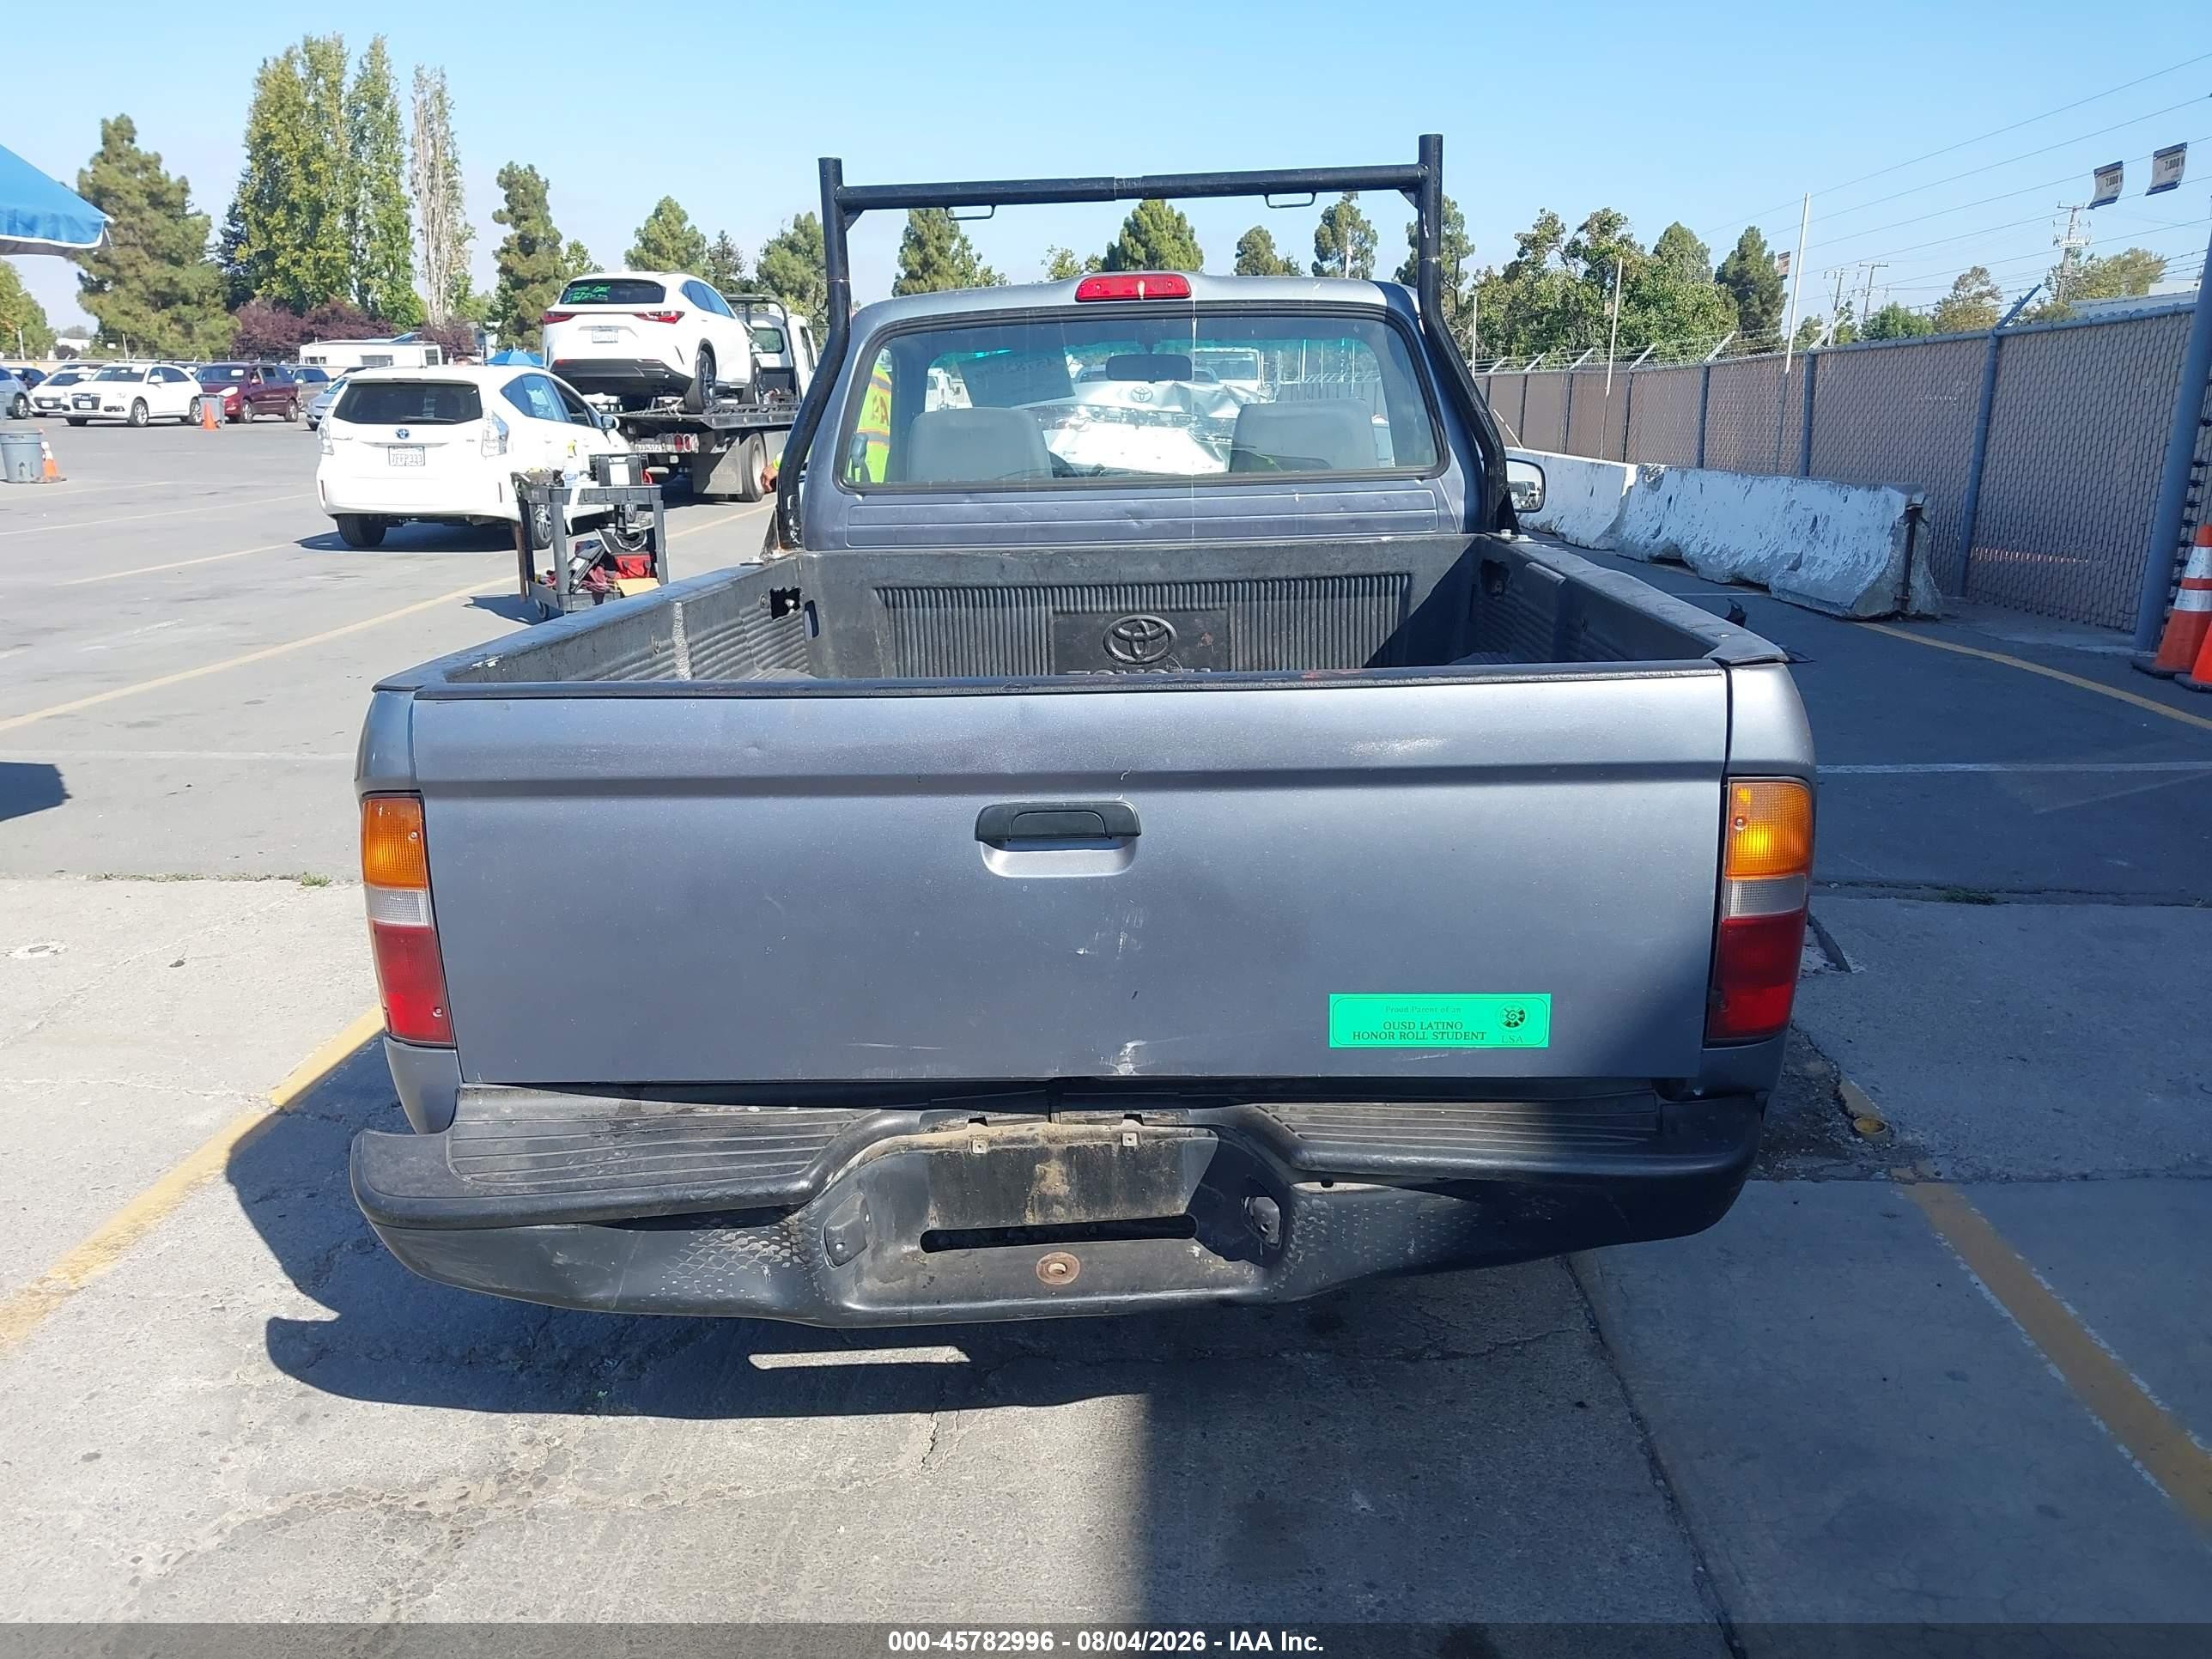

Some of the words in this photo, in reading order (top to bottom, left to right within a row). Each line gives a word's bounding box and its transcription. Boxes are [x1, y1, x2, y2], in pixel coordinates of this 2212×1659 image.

[1382, 1021, 1416, 1030] OUSD
[1420, 1021, 1463, 1030] LATINO
[1352, 1031, 1395, 1041] HONOR
[1399, 1031, 1429, 1041] ROLL
[1432, 1031, 1486, 1041] STUDENT
